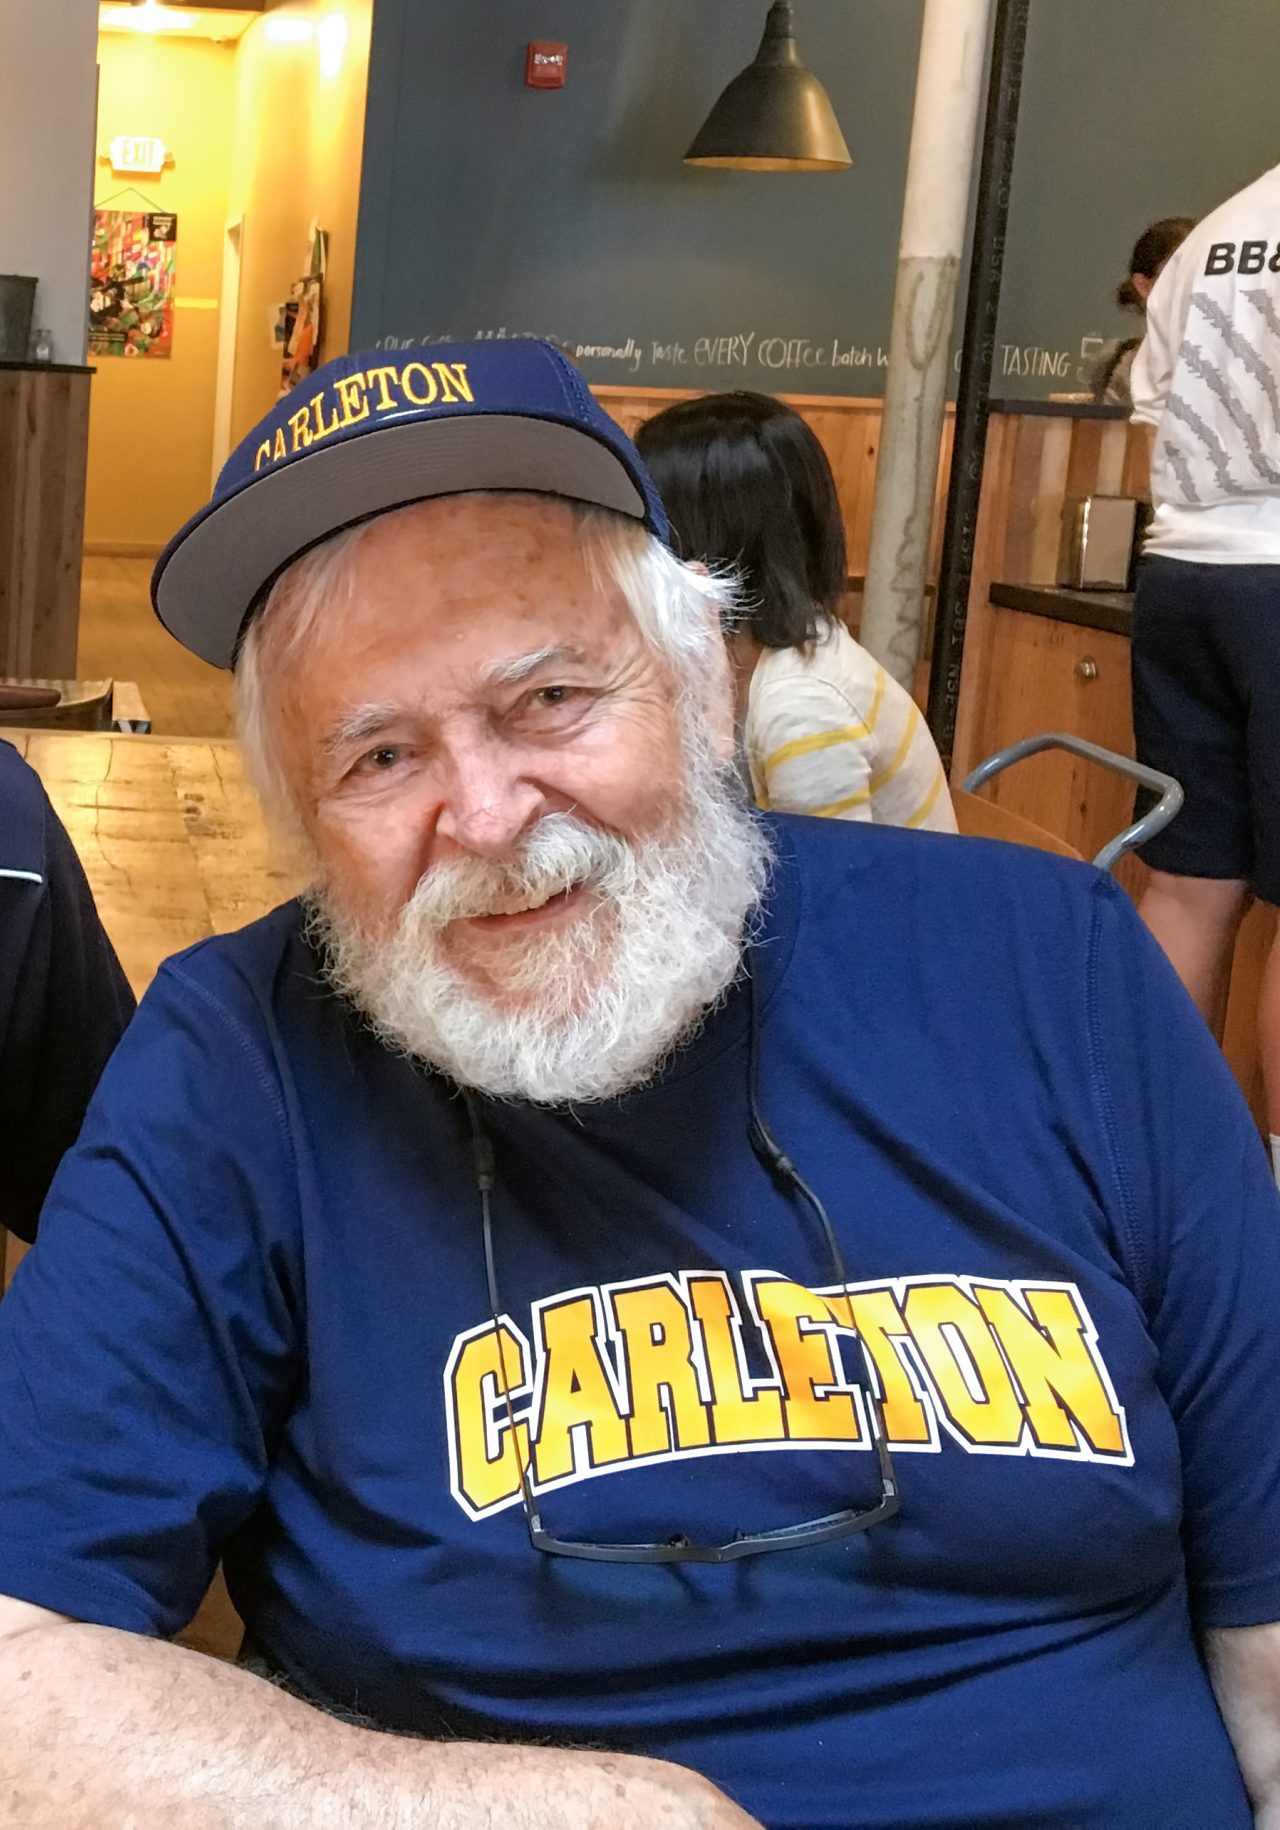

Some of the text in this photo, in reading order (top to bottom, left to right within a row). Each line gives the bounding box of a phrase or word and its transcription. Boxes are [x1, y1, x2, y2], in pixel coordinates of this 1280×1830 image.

[121, 140, 156, 166] EXIT
[576, 337, 643, 372] personally
[694, 331, 756, 367] EVERY
[1000, 344, 1072, 378] TASTING
[255, 362, 475, 472] CARLETON
[444, 1270, 1135, 1522] CARLETON
